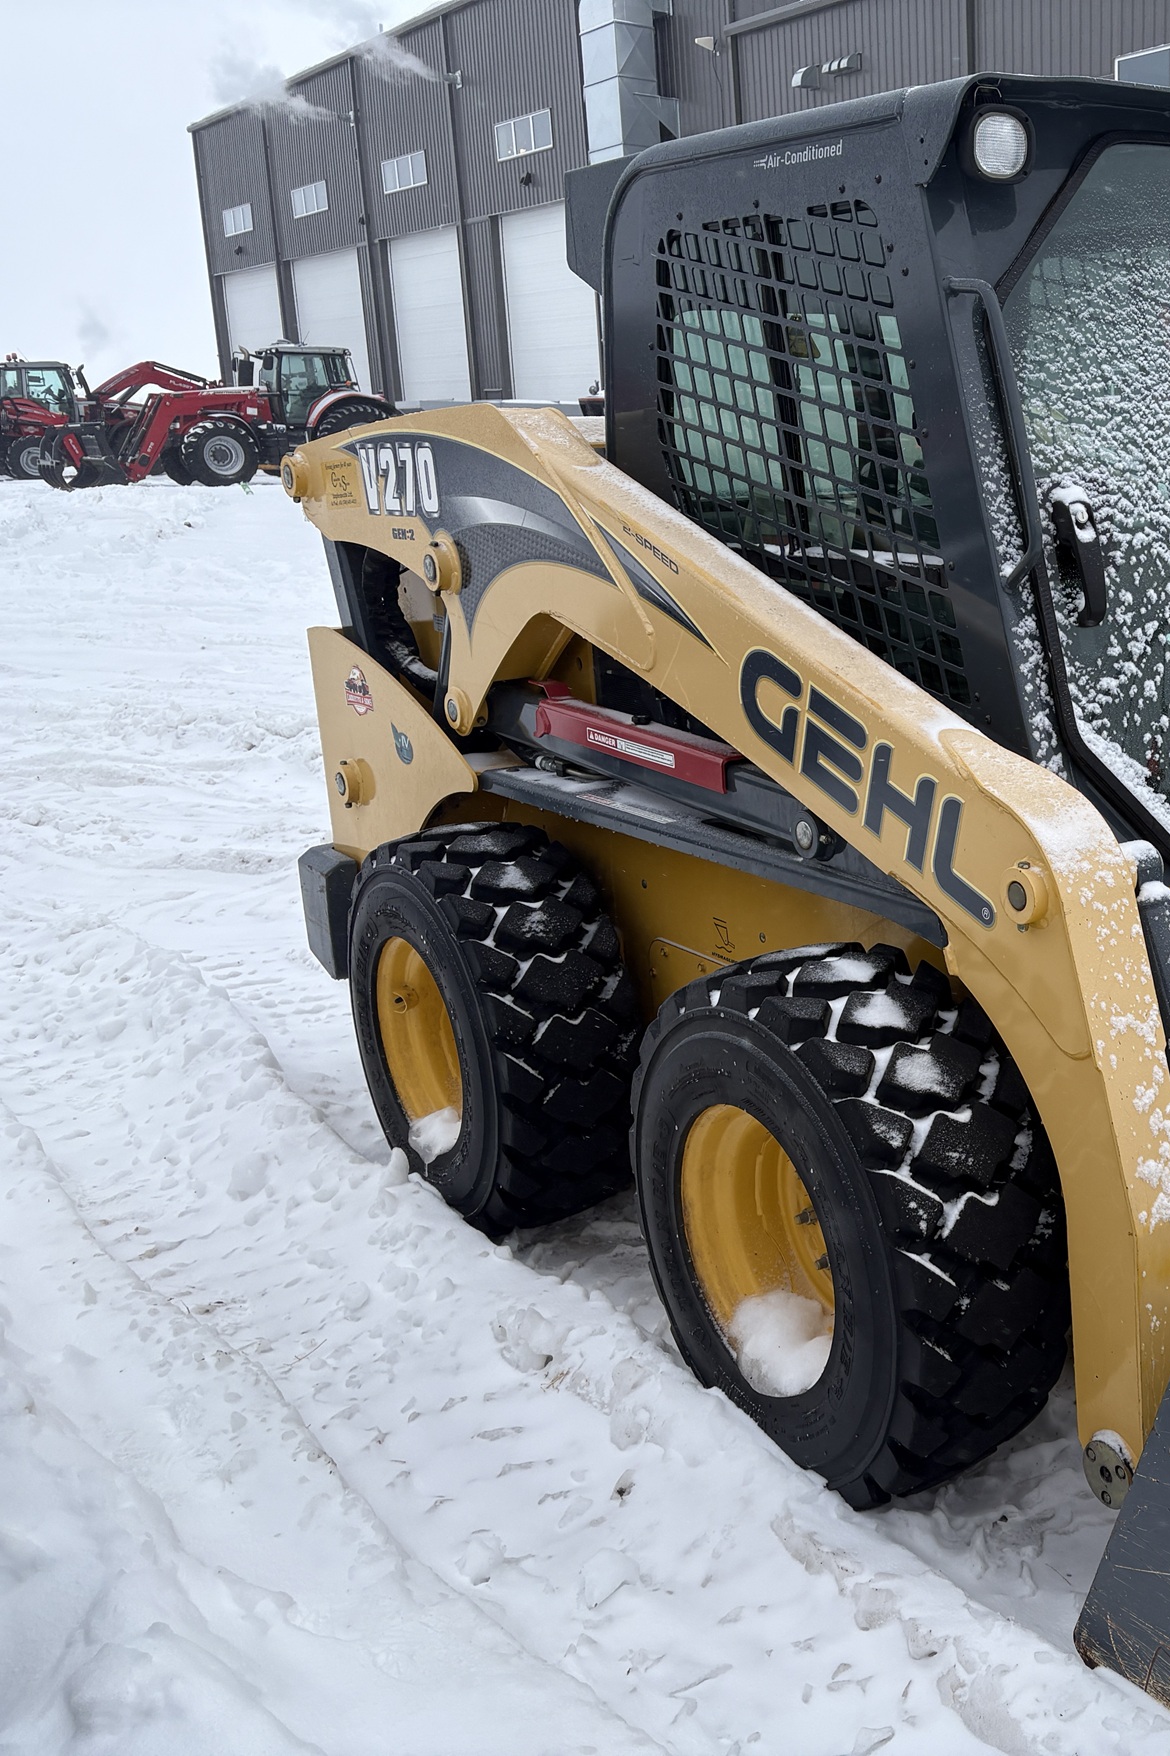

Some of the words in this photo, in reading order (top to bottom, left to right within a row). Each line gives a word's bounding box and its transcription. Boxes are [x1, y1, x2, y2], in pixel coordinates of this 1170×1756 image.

[767, 139, 843, 169] Air-Conditioned
[356, 441, 441, 518] V270
[622, 525, 679, 575] 2-SPEED
[594, 732, 616, 747] DANGER
[739, 645, 997, 930] GEHL
